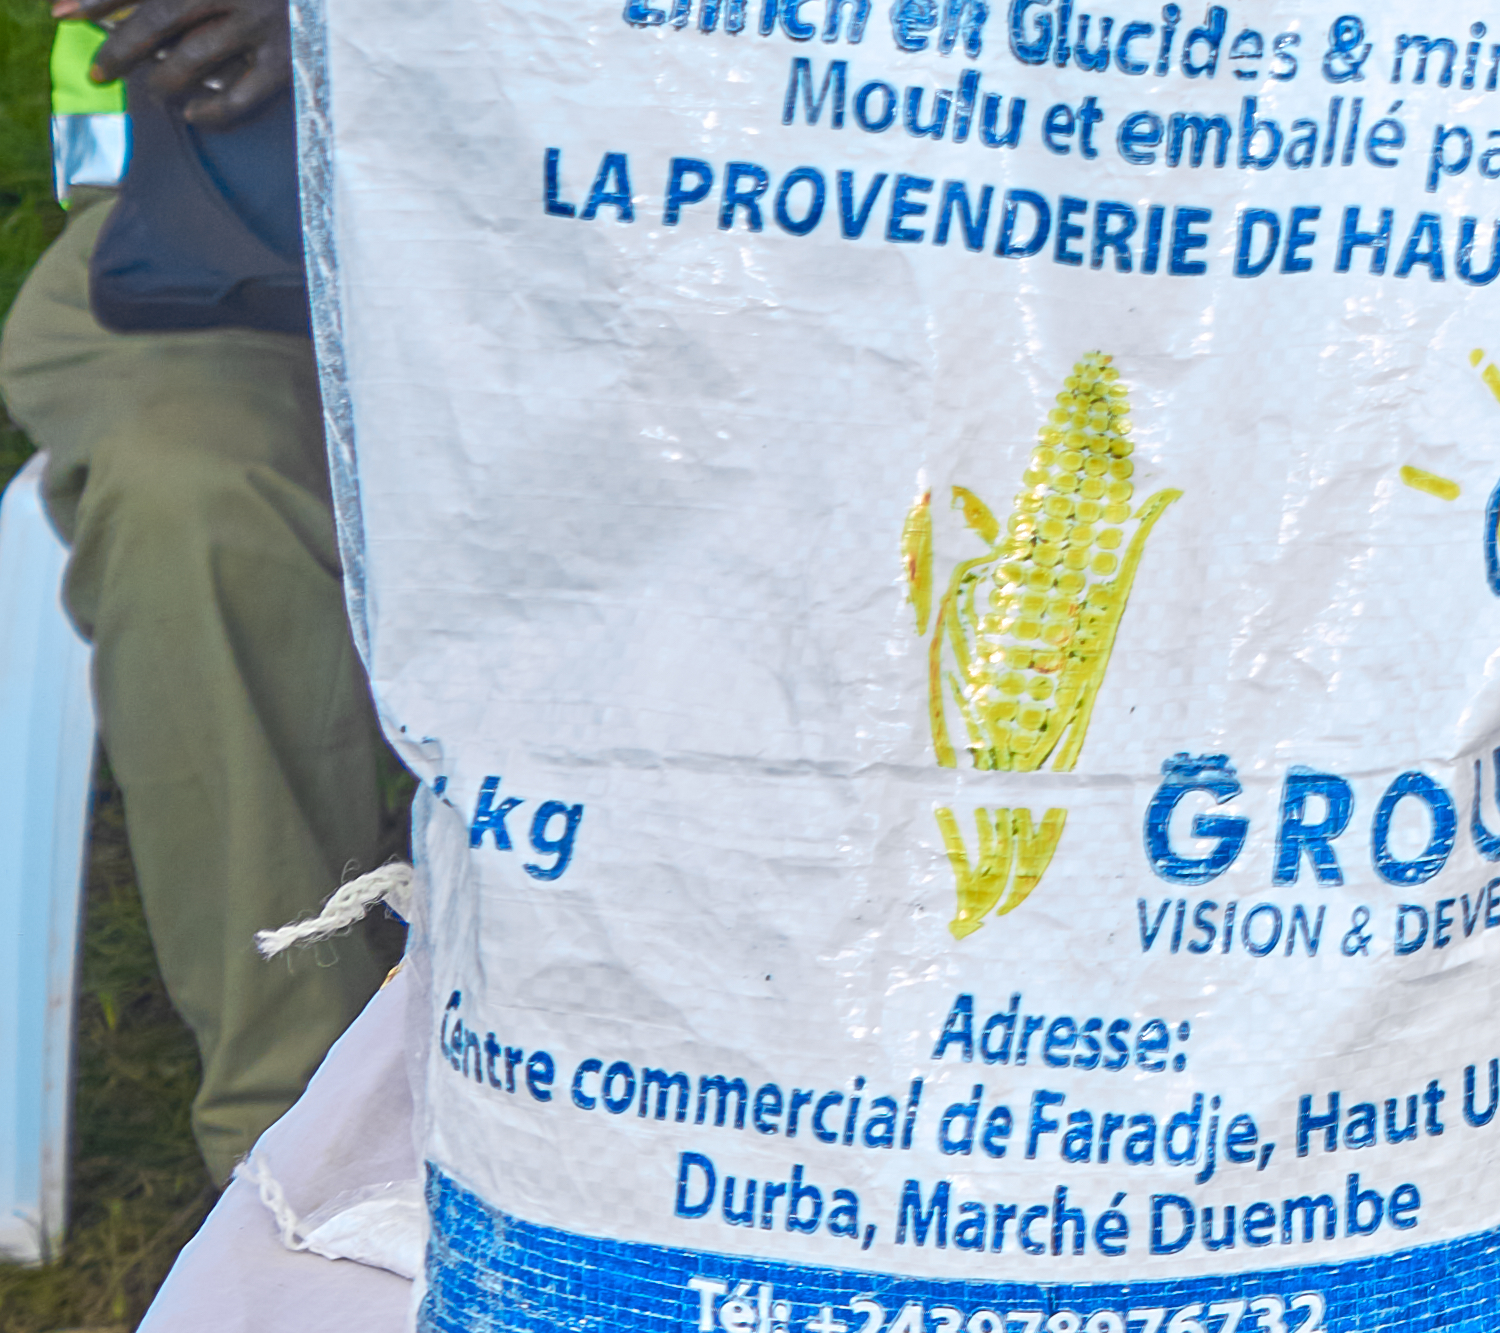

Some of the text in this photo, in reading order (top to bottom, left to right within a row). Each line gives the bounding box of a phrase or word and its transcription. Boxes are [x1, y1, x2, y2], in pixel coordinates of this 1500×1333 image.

[1321, 14, 1372, 85] &
[780, 56, 1027, 151] Moulu
[1041, 95, 1103, 161] et
[1115, 95, 1406, 170] emballé
[542, 146, 635, 224] LA
[661, 156, 1212, 276] PROVENDERIE
[1231, 204, 1322, 279] DE
[468, 774, 585, 882] kg
[1136, 898, 1327, 959] VISION
[1340, 904, 1374, 958] &
[931, 991, 1192, 1073] Adresse:
[440, 989, 557, 1103] Centre
[570, 1056, 924, 1151] commercial
[937, 1082, 1015, 1160] de
[1024, 1088, 1277, 1185] Faradje,
[1295, 1077, 1447, 1159] Haut
[673, 1150, 1421, 1259] Durba, Marché Duembe
